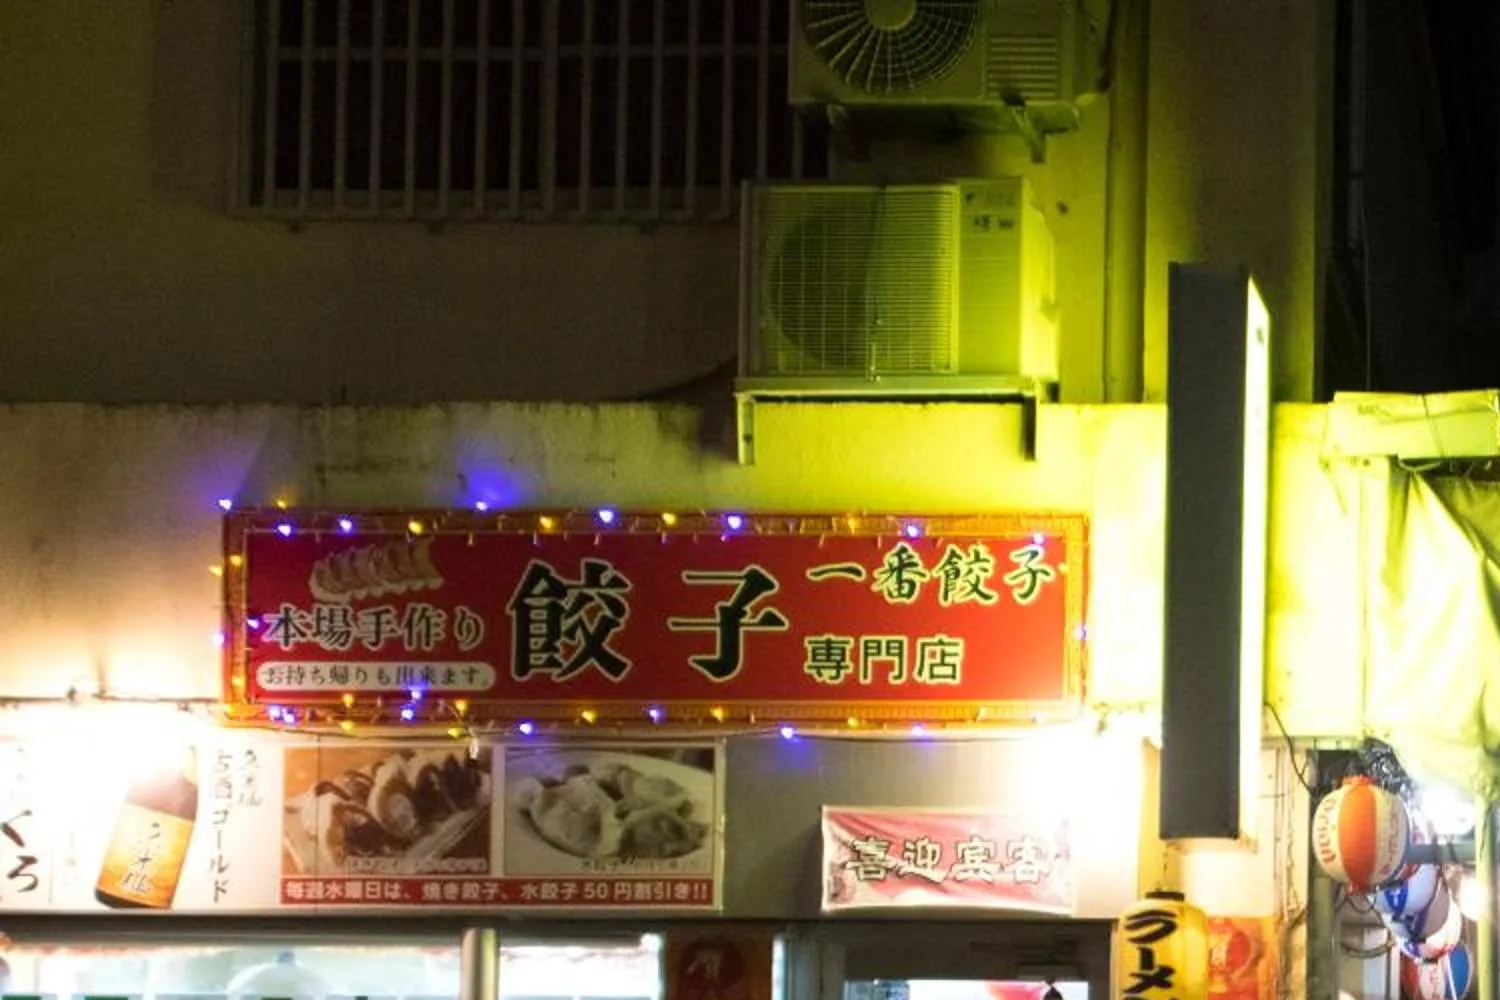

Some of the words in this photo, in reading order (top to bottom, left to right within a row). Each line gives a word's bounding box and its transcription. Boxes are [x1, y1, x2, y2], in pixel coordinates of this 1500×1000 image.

[807, 543, 1056, 604] 一番餃子
[263, 606, 485, 648] 本場手作り
[509, 560, 788, 682] 餃子
[805, 636, 963, 684] 専門店
